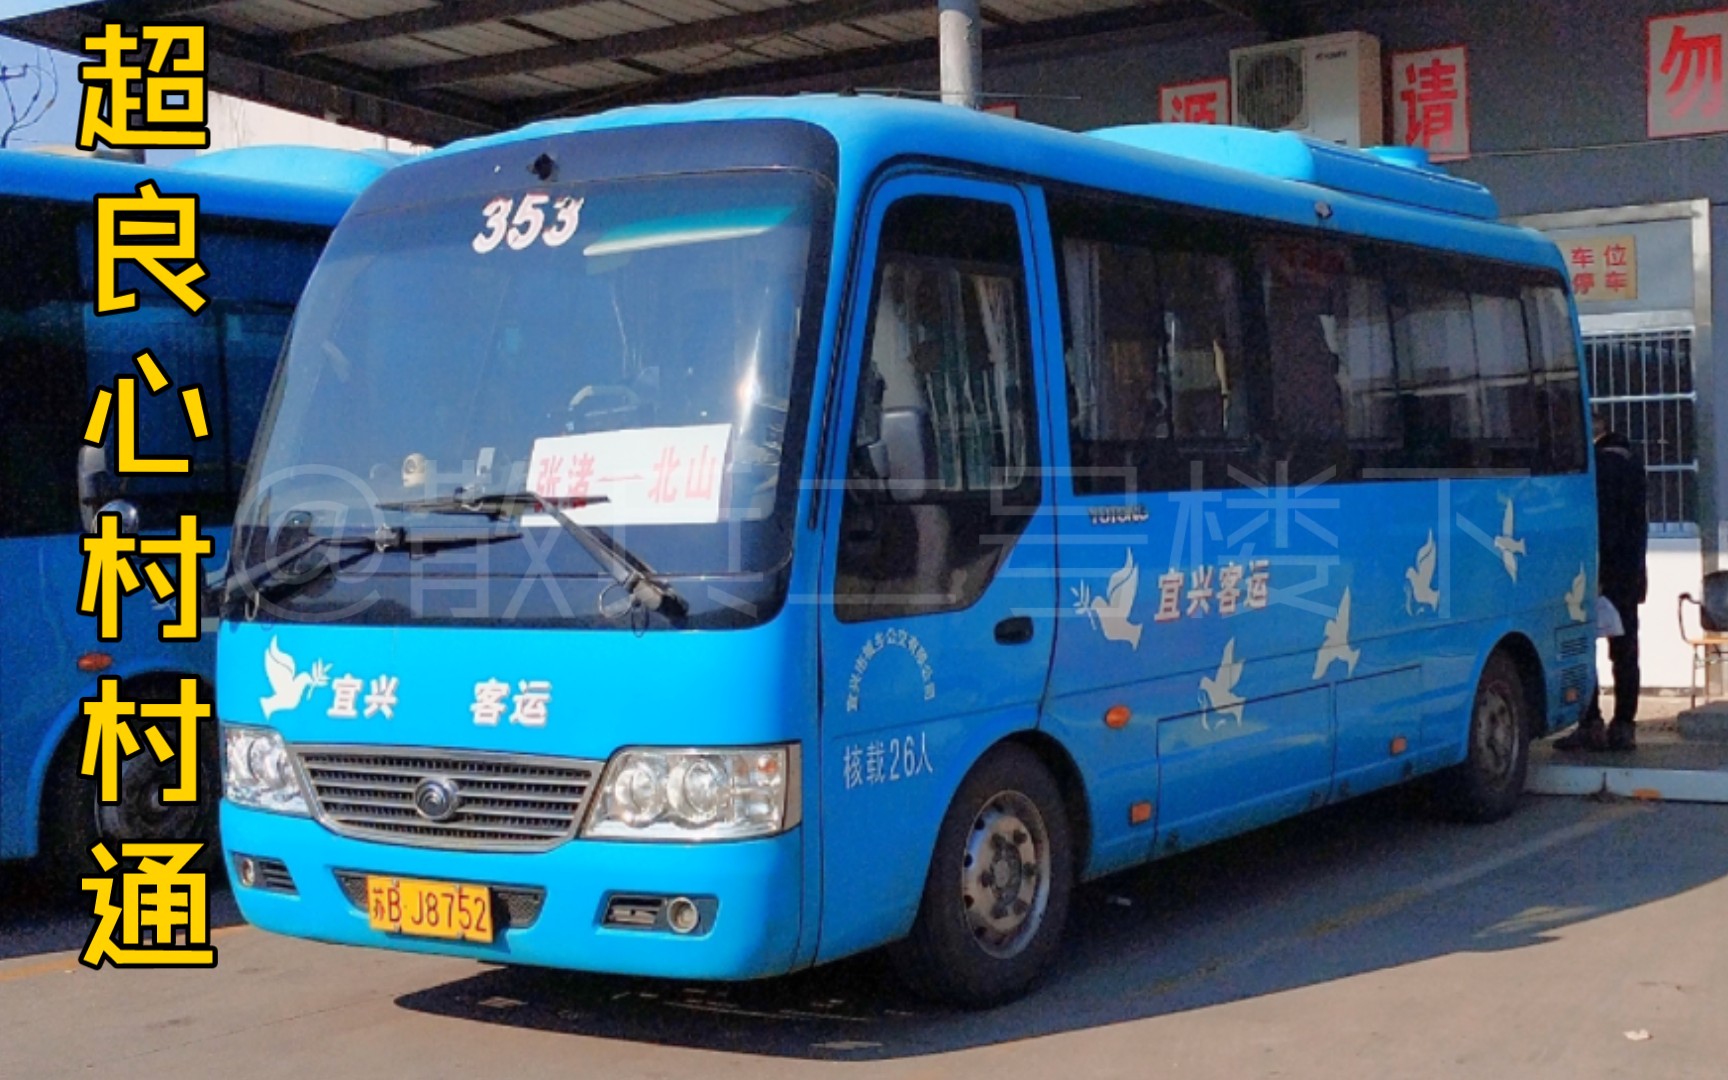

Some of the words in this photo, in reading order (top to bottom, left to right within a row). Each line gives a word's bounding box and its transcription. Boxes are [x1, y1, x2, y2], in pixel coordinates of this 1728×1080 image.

[1400, 58, 1458, 149] 请
[1660, 25, 1723, 119] 勿
[471, 192, 585, 255] 353
[1571, 244, 1626, 268] 车位
[1153, 558, 1270, 624] 宜兴客运
[326, 675, 400, 719] 宜兴
[469, 679, 552, 728] 客运
[843, 731, 933, 789] 核载26人
